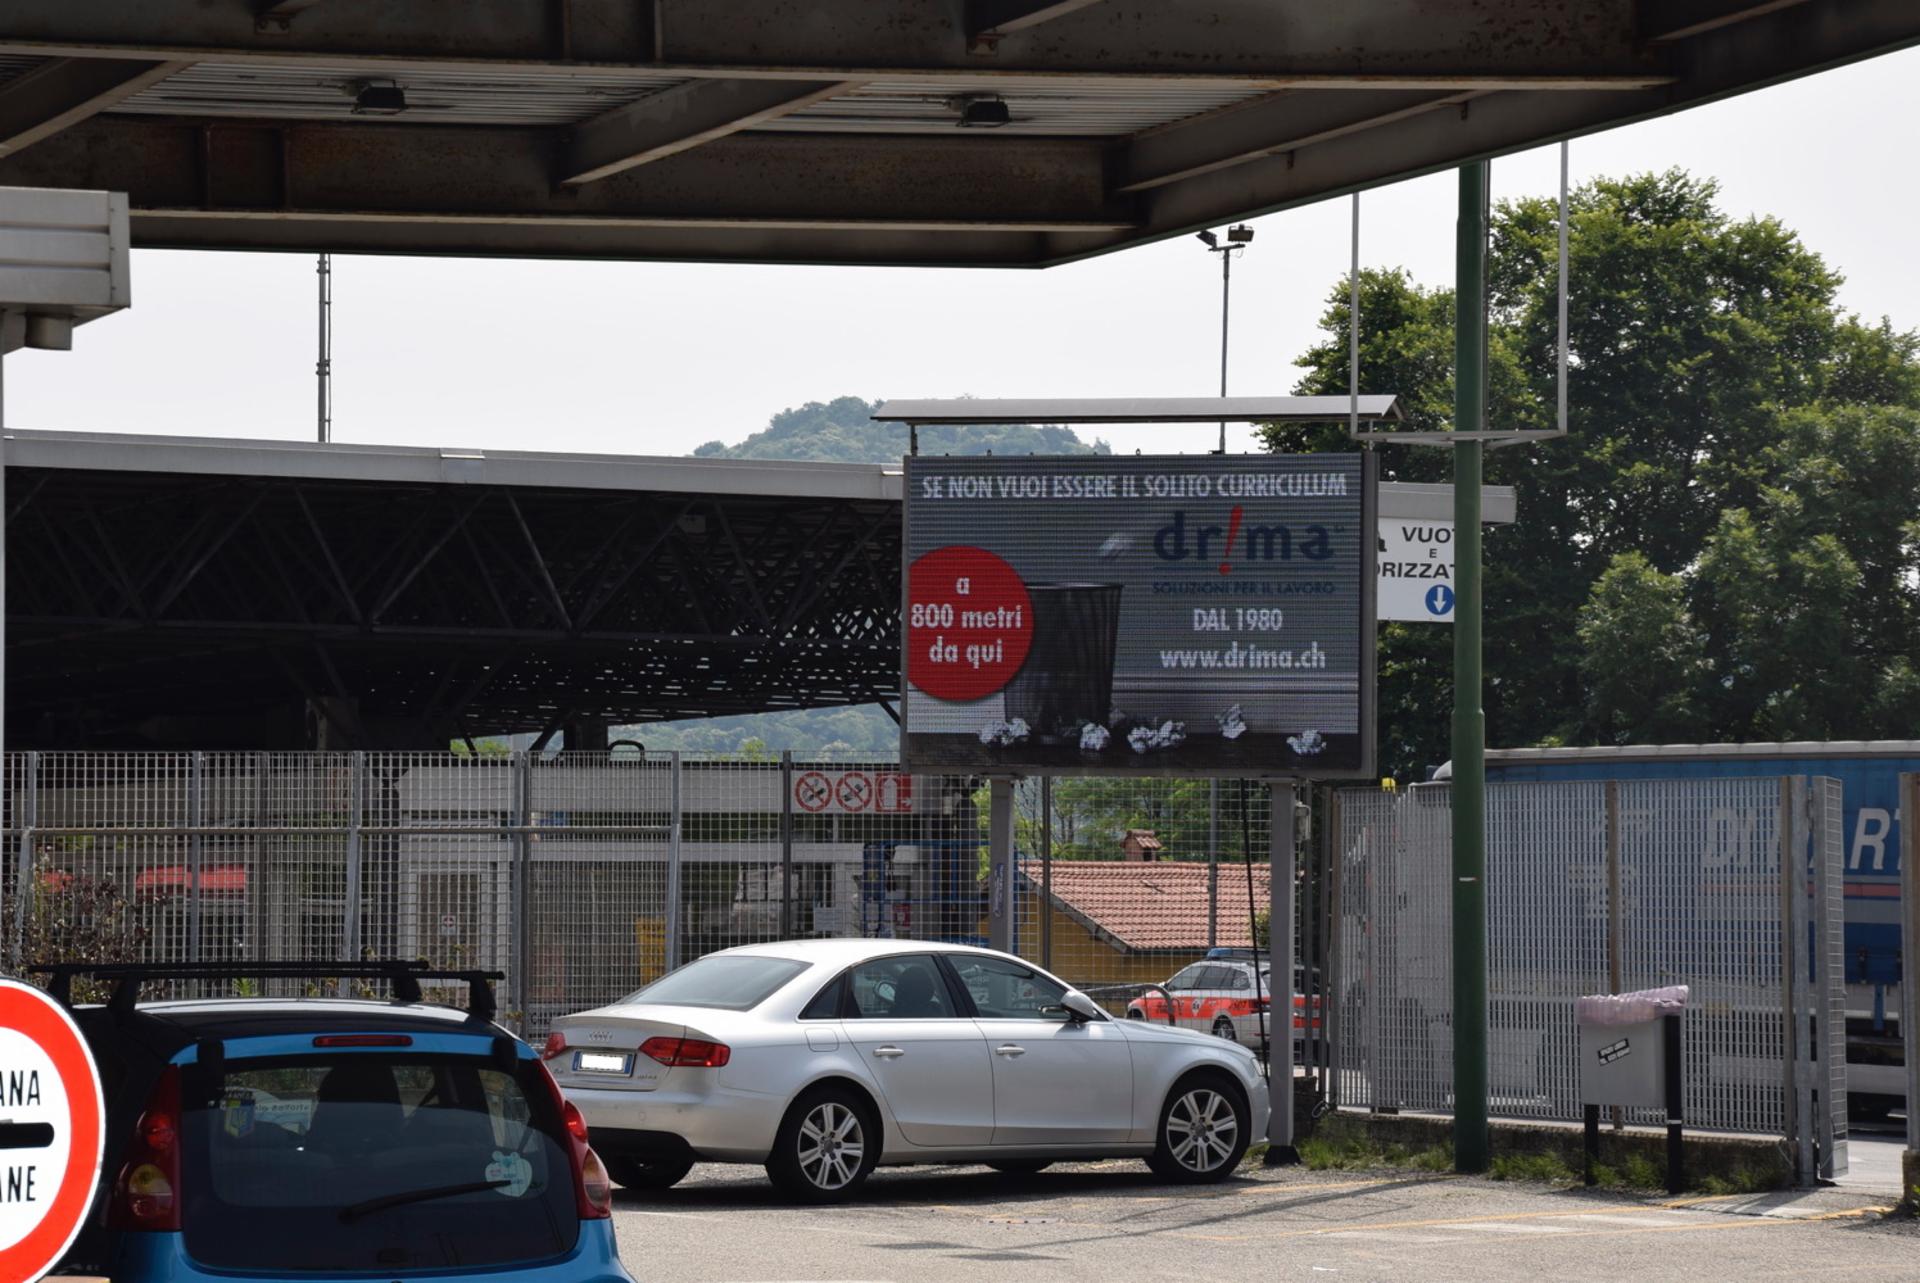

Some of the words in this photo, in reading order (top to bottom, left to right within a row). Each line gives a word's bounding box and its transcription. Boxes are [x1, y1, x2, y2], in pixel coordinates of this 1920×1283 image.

[922, 476, 942, 499] SE
[949, 476, 993, 498] NON
[997, 476, 1047, 498] VUOI
[1053, 475, 1117, 498] ESSERE
[1122, 475, 1140, 498] IL
[1144, 474, 1211, 498] SOLITO
[1217, 473, 1347, 497] CURRICULUM
[1402, 526, 1454, 544] VUO
[1429, 548, 1438, 559] E
[1377, 562, 1454, 579] RIZZA
[956, 579, 969, 595] a
[910, 604, 954, 628] 800
[961, 605, 1022, 629] metri
[1193, 608, 1231, 631] DAL
[1236, 608, 1284, 631] 1980
[929, 637, 959, 663] da
[966, 638, 1003, 668] qui
[1160, 642, 1326, 669] www.drima.ch
